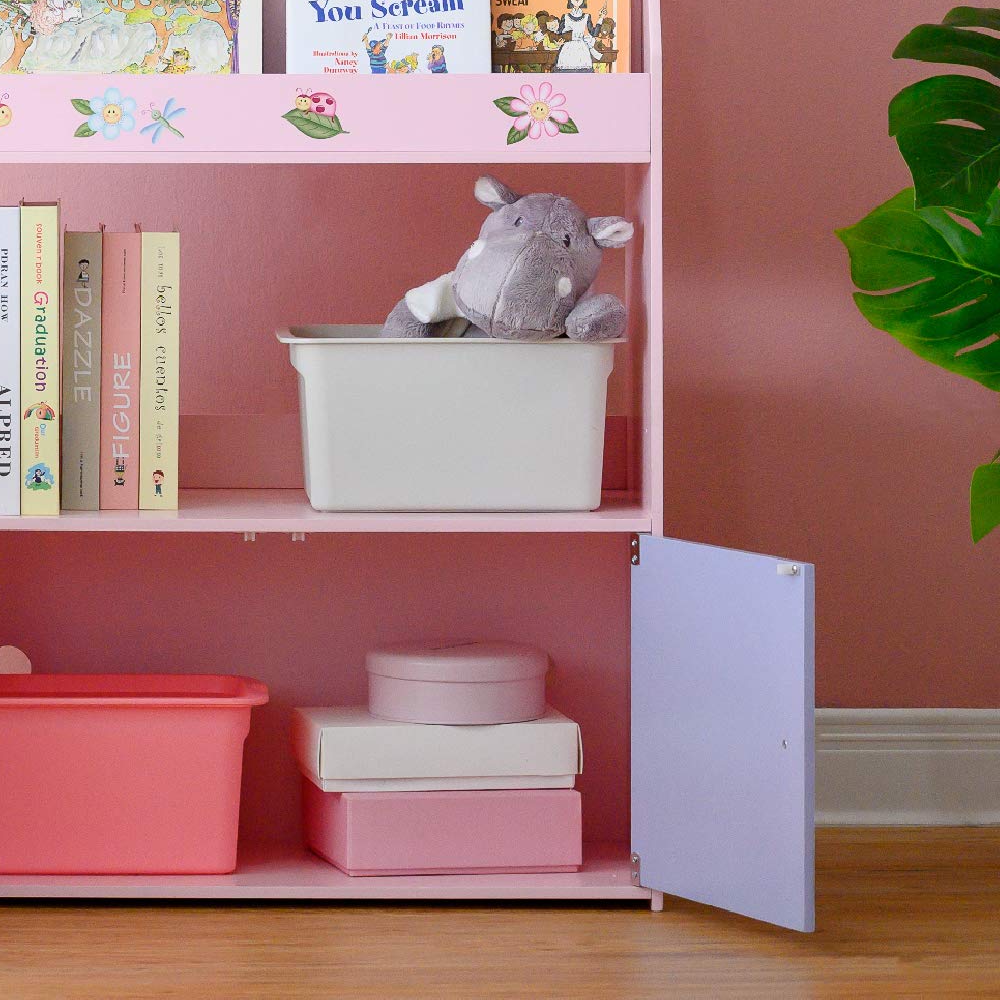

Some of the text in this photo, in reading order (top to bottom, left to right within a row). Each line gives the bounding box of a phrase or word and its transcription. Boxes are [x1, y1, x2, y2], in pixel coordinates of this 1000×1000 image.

[308, 0, 362, 23] You
[420, 32, 457, 40] Morrison
[35, 223, 43, 261] souvenr
[0, 294, 9, 324] HOW
[155, 284, 173, 335] bellos
[33, 290, 50, 392] Graduation
[73, 287, 93, 403] DAZZLE
[112, 352, 132, 459] FIGURE
